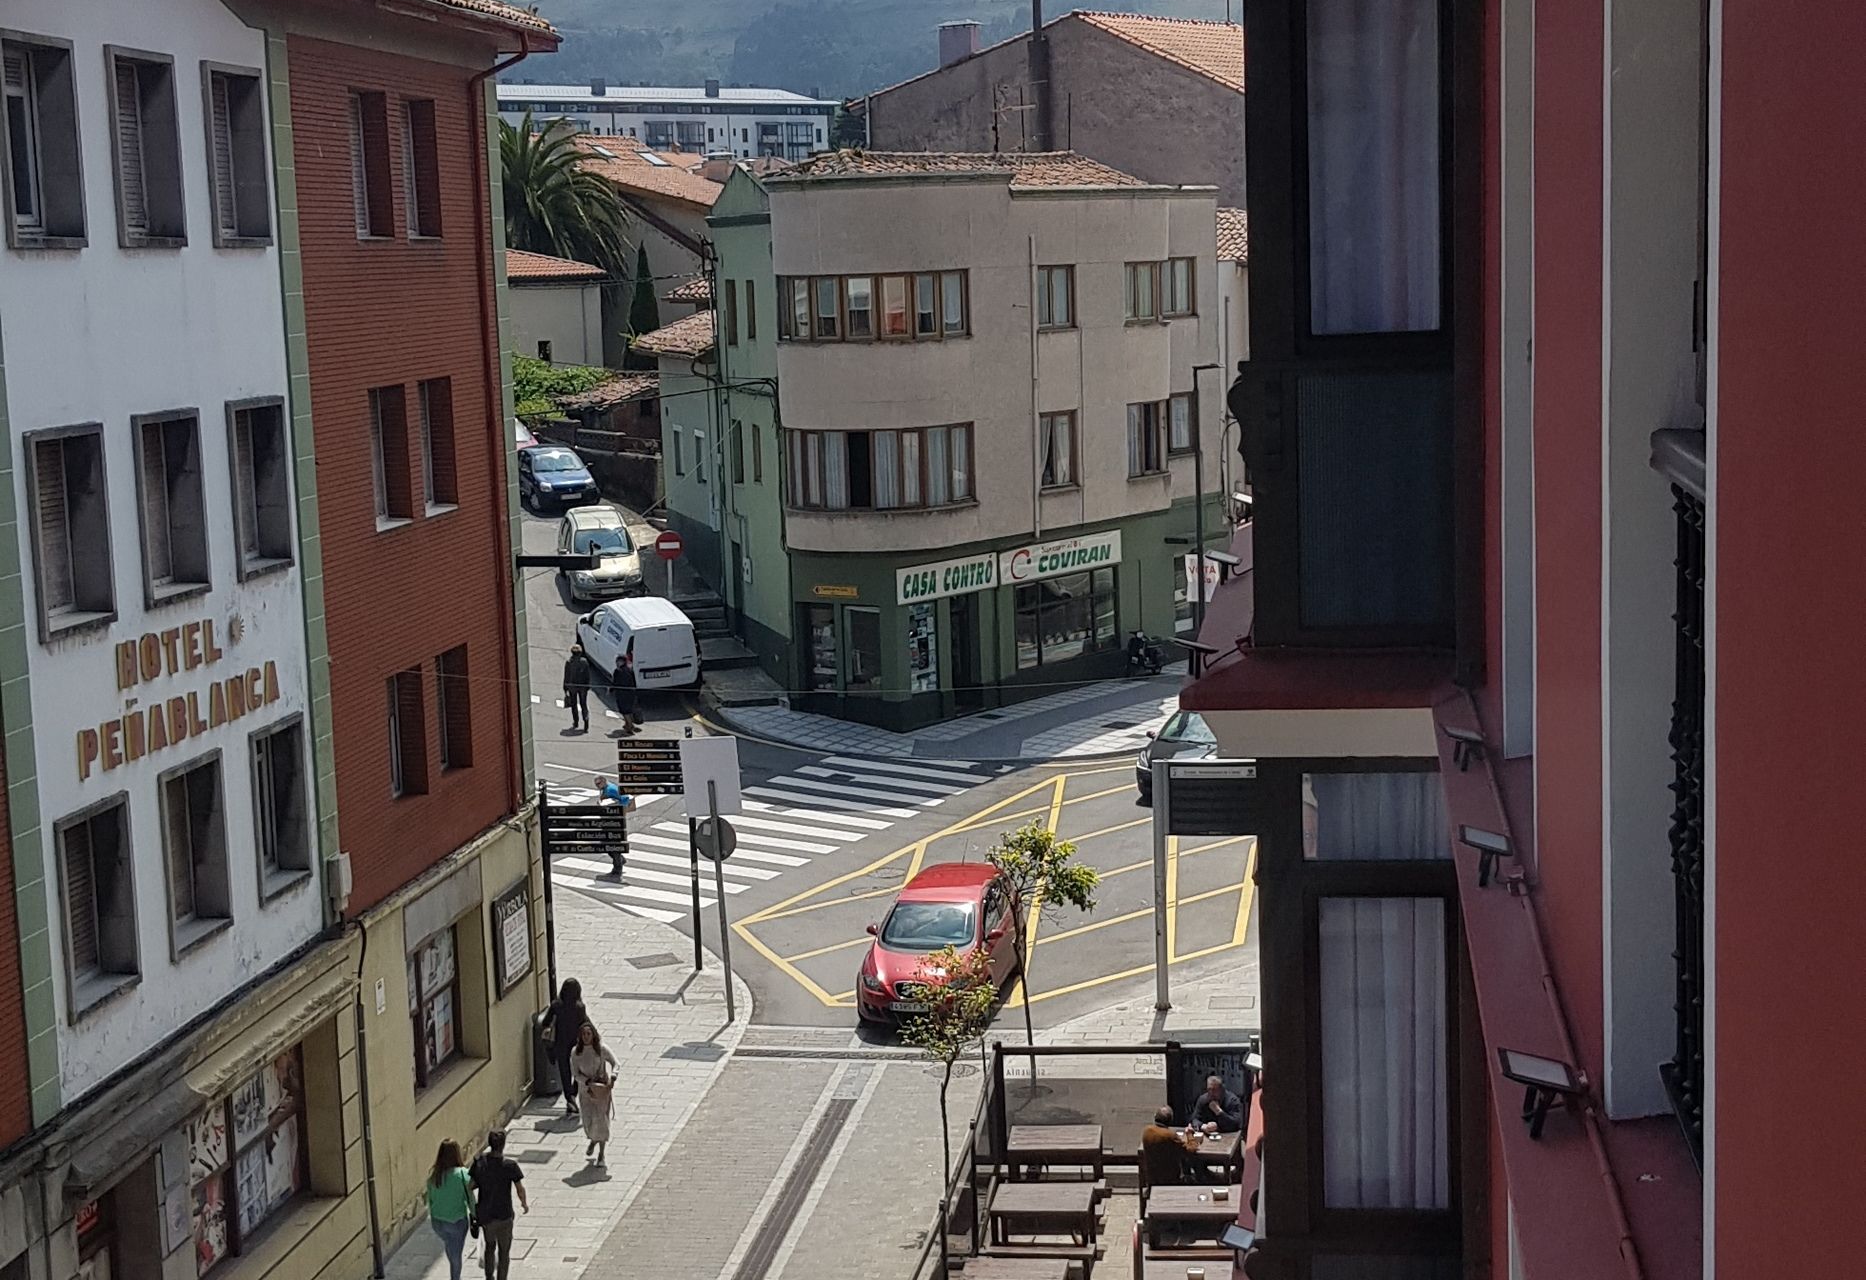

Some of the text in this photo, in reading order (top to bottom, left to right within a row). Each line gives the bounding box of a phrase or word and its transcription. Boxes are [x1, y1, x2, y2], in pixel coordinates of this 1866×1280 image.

[903, 554, 993, 600] CASA CONTRÓ
[1038, 543, 1111, 573] COVIRAN
[116, 619, 223, 690] HOTEL
[78, 660, 280, 782] PEÑABLANCA
